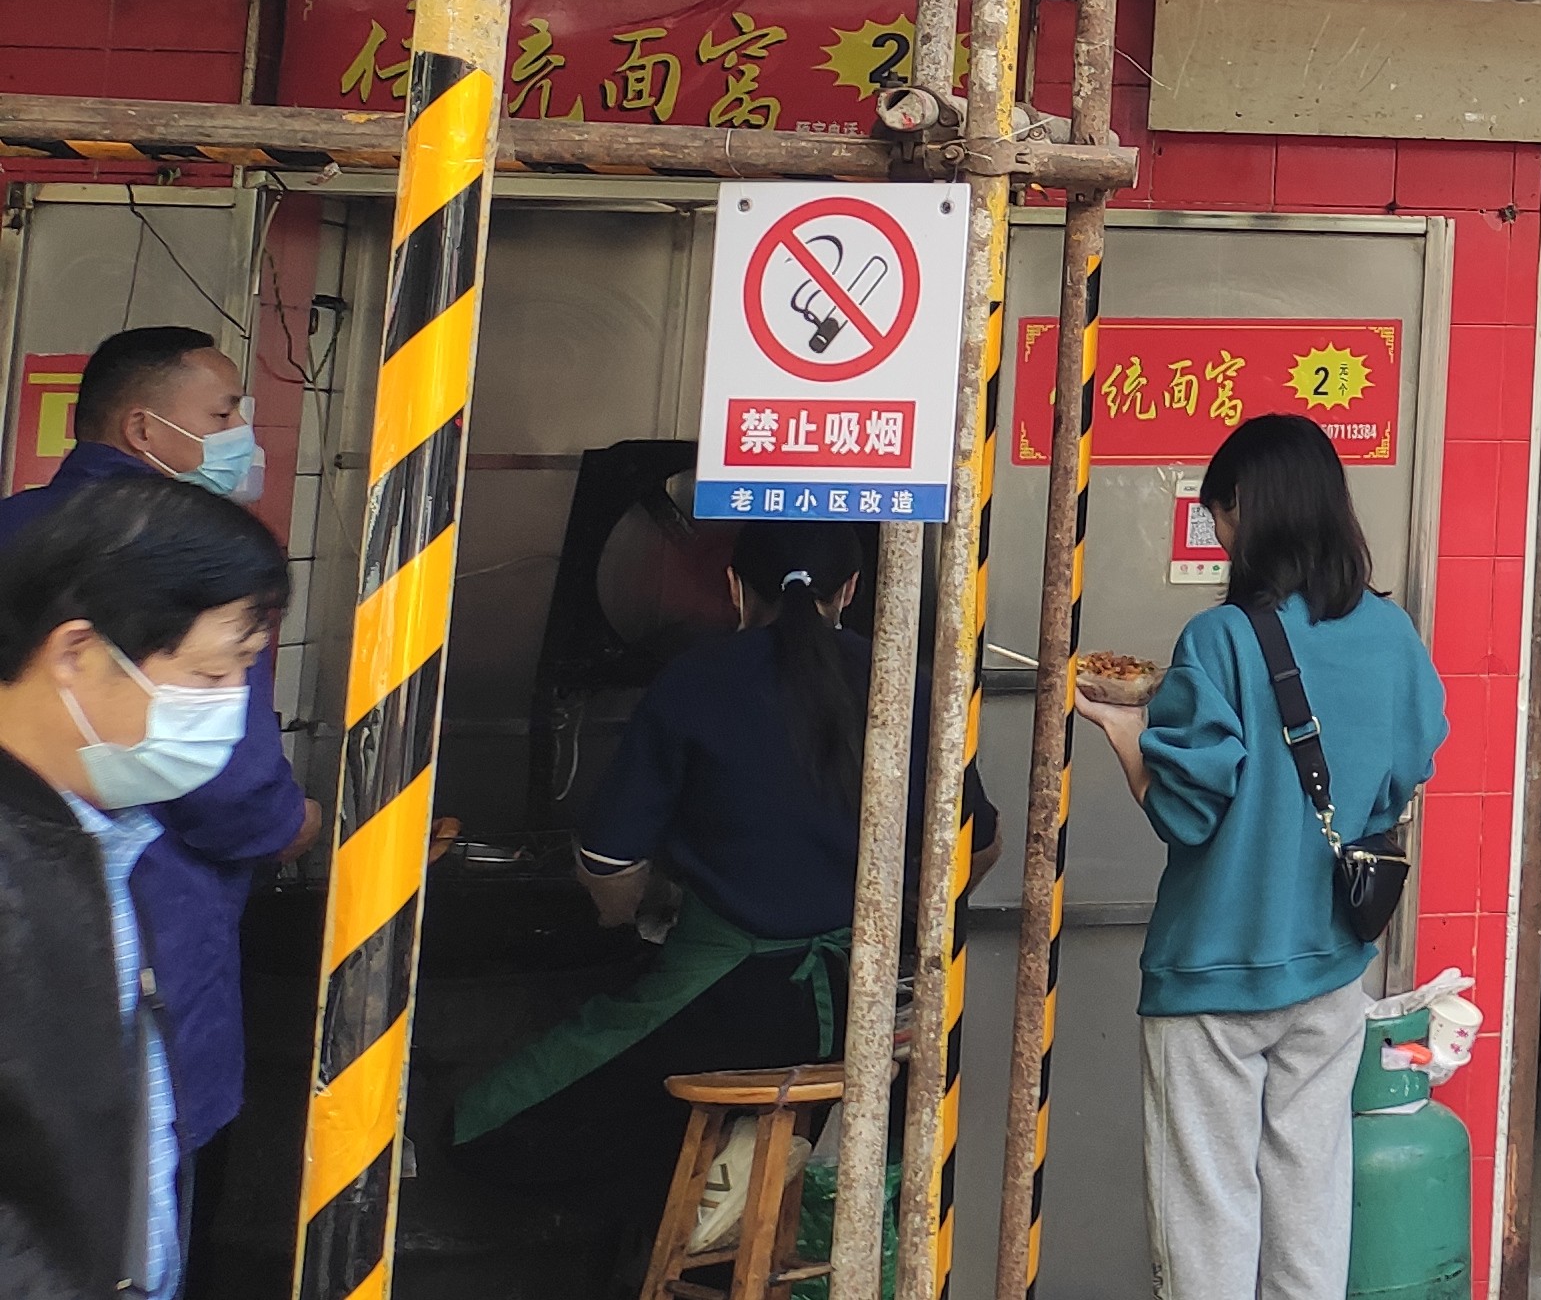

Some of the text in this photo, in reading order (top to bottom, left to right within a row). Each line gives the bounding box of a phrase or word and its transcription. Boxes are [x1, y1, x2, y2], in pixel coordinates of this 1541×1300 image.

[1049, 350, 1246, 427] 统面窝
[739, 407, 905, 456] 禁止吸烟
[730, 487, 915, 514] 老旧小区改造
